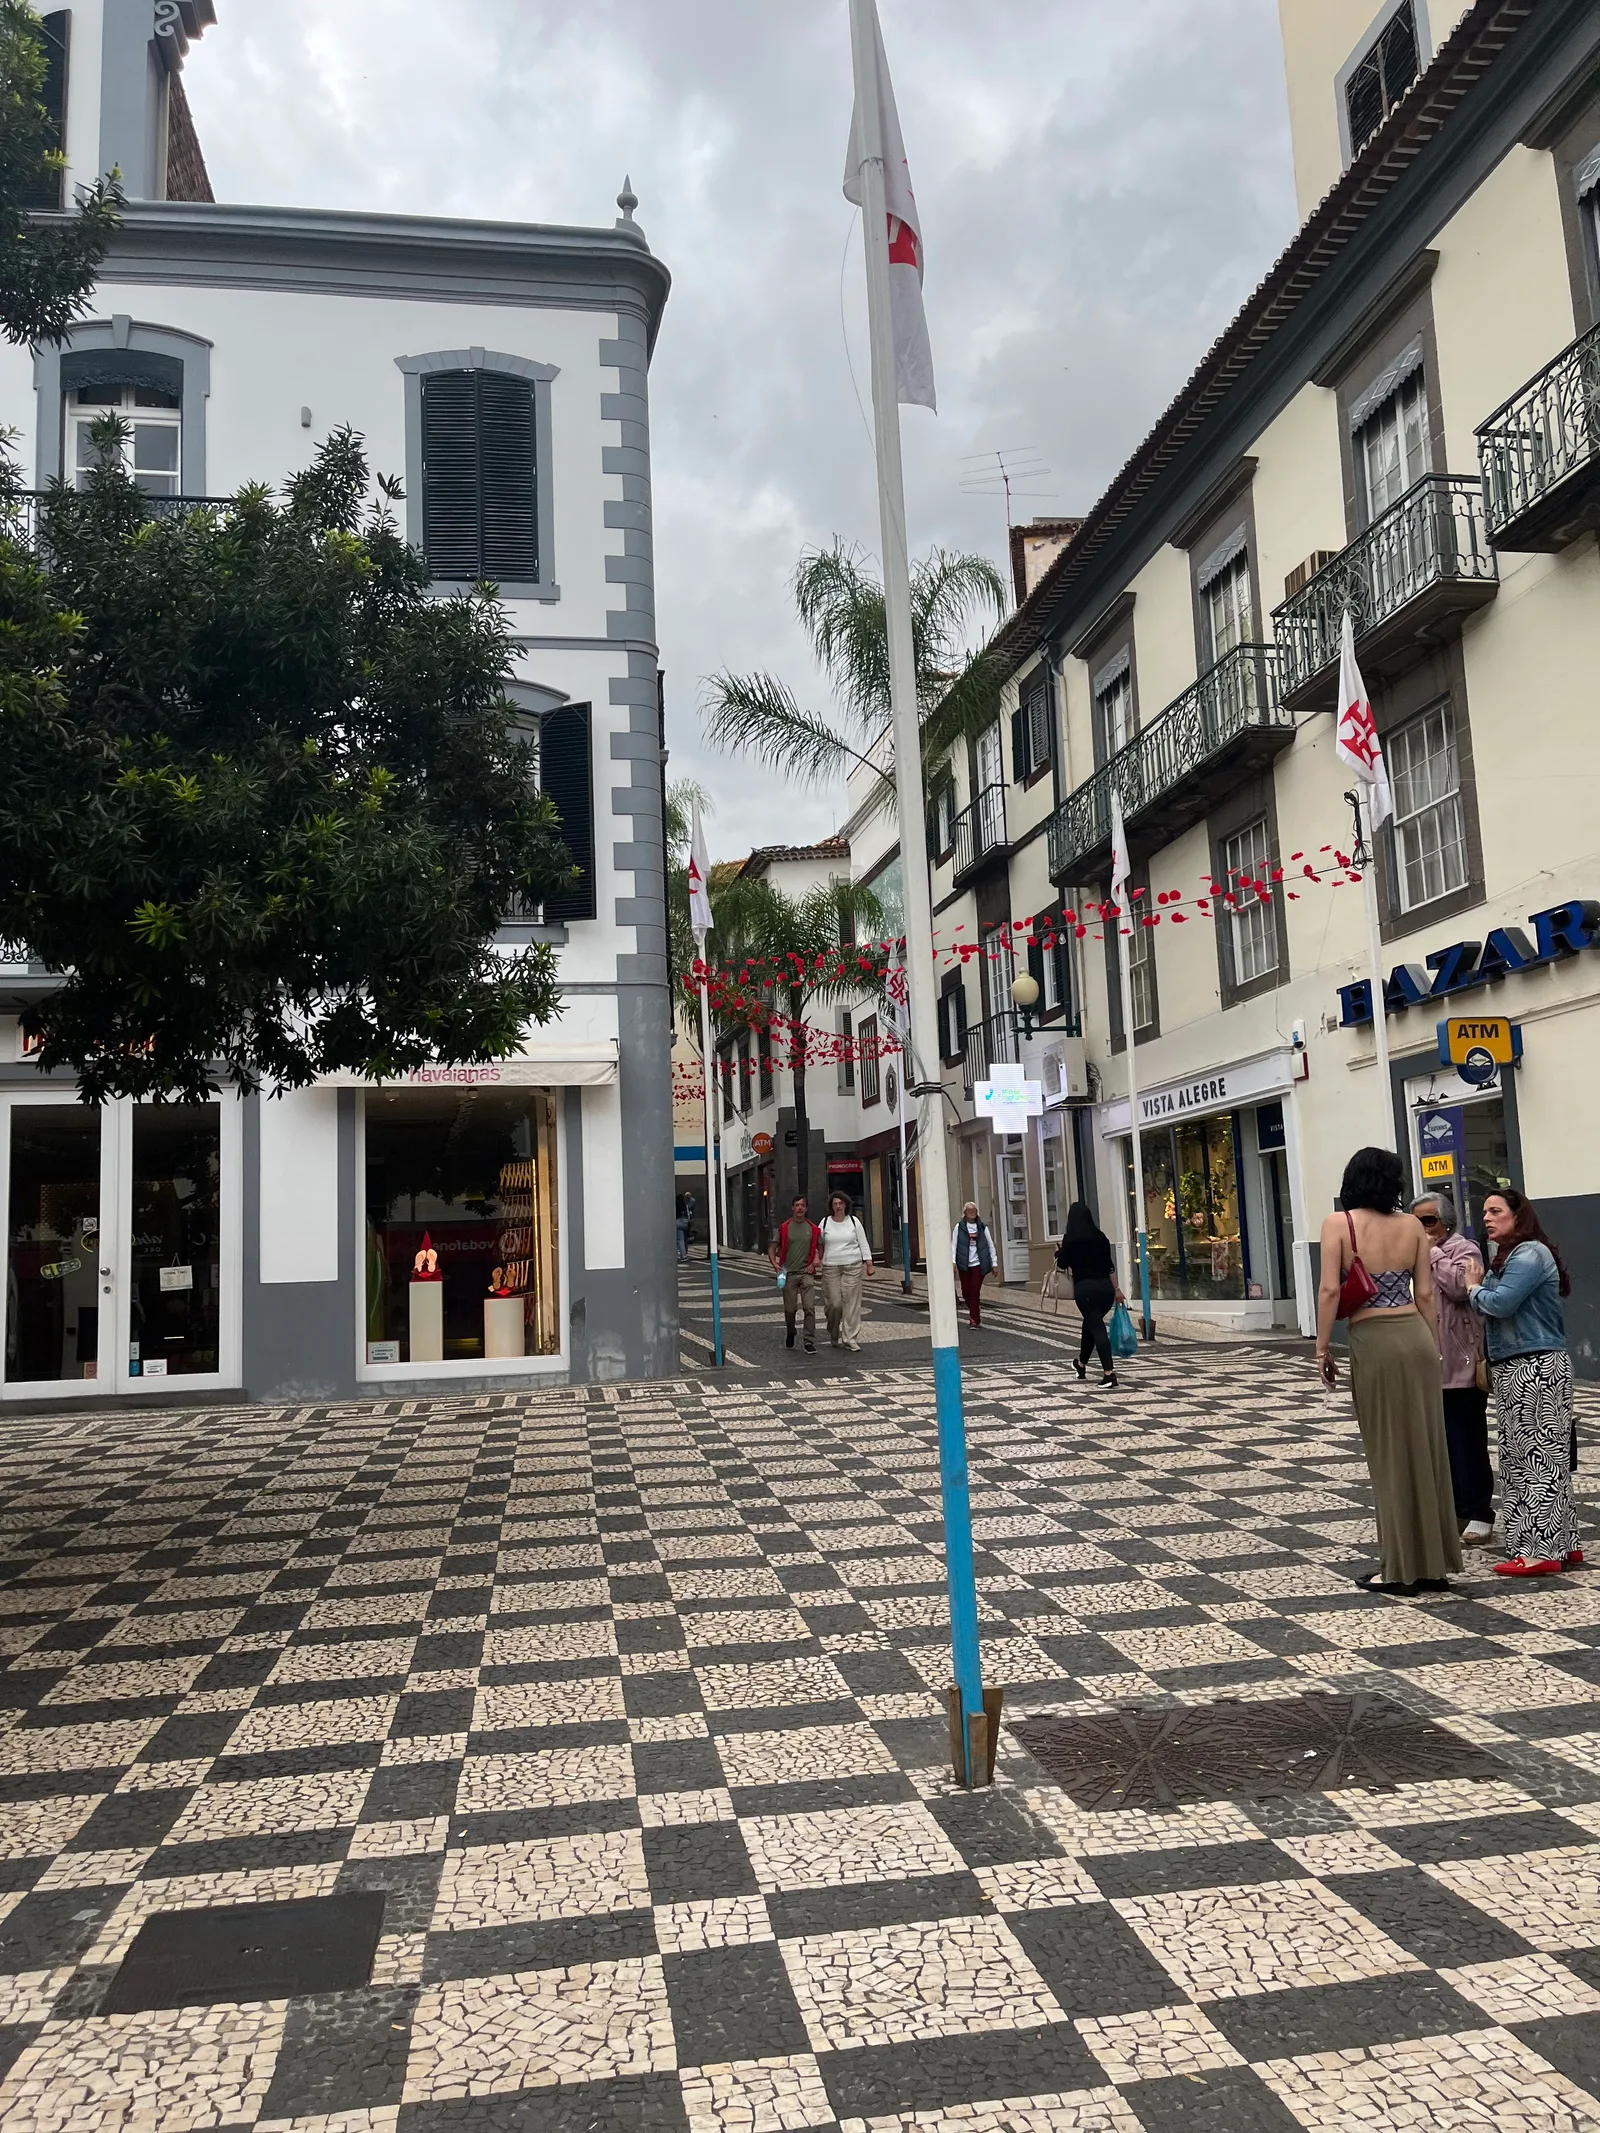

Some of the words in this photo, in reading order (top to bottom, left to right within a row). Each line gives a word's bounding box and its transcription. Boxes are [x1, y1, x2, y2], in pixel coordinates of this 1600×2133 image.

[1337, 900, 1600, 1027] BAZAR
[1456, 1023, 1500, 1039] ATM
[409, 1065, 501, 1084] havaianas
[1142, 1093, 1175, 1117] VISTA
[1178, 1077, 1227, 1108] ALEGRE
[754, 1139, 771, 1147] ATM
[1427, 1159, 1448, 1172] ATM
[42, 1260, 80, 1278] CLOSED
